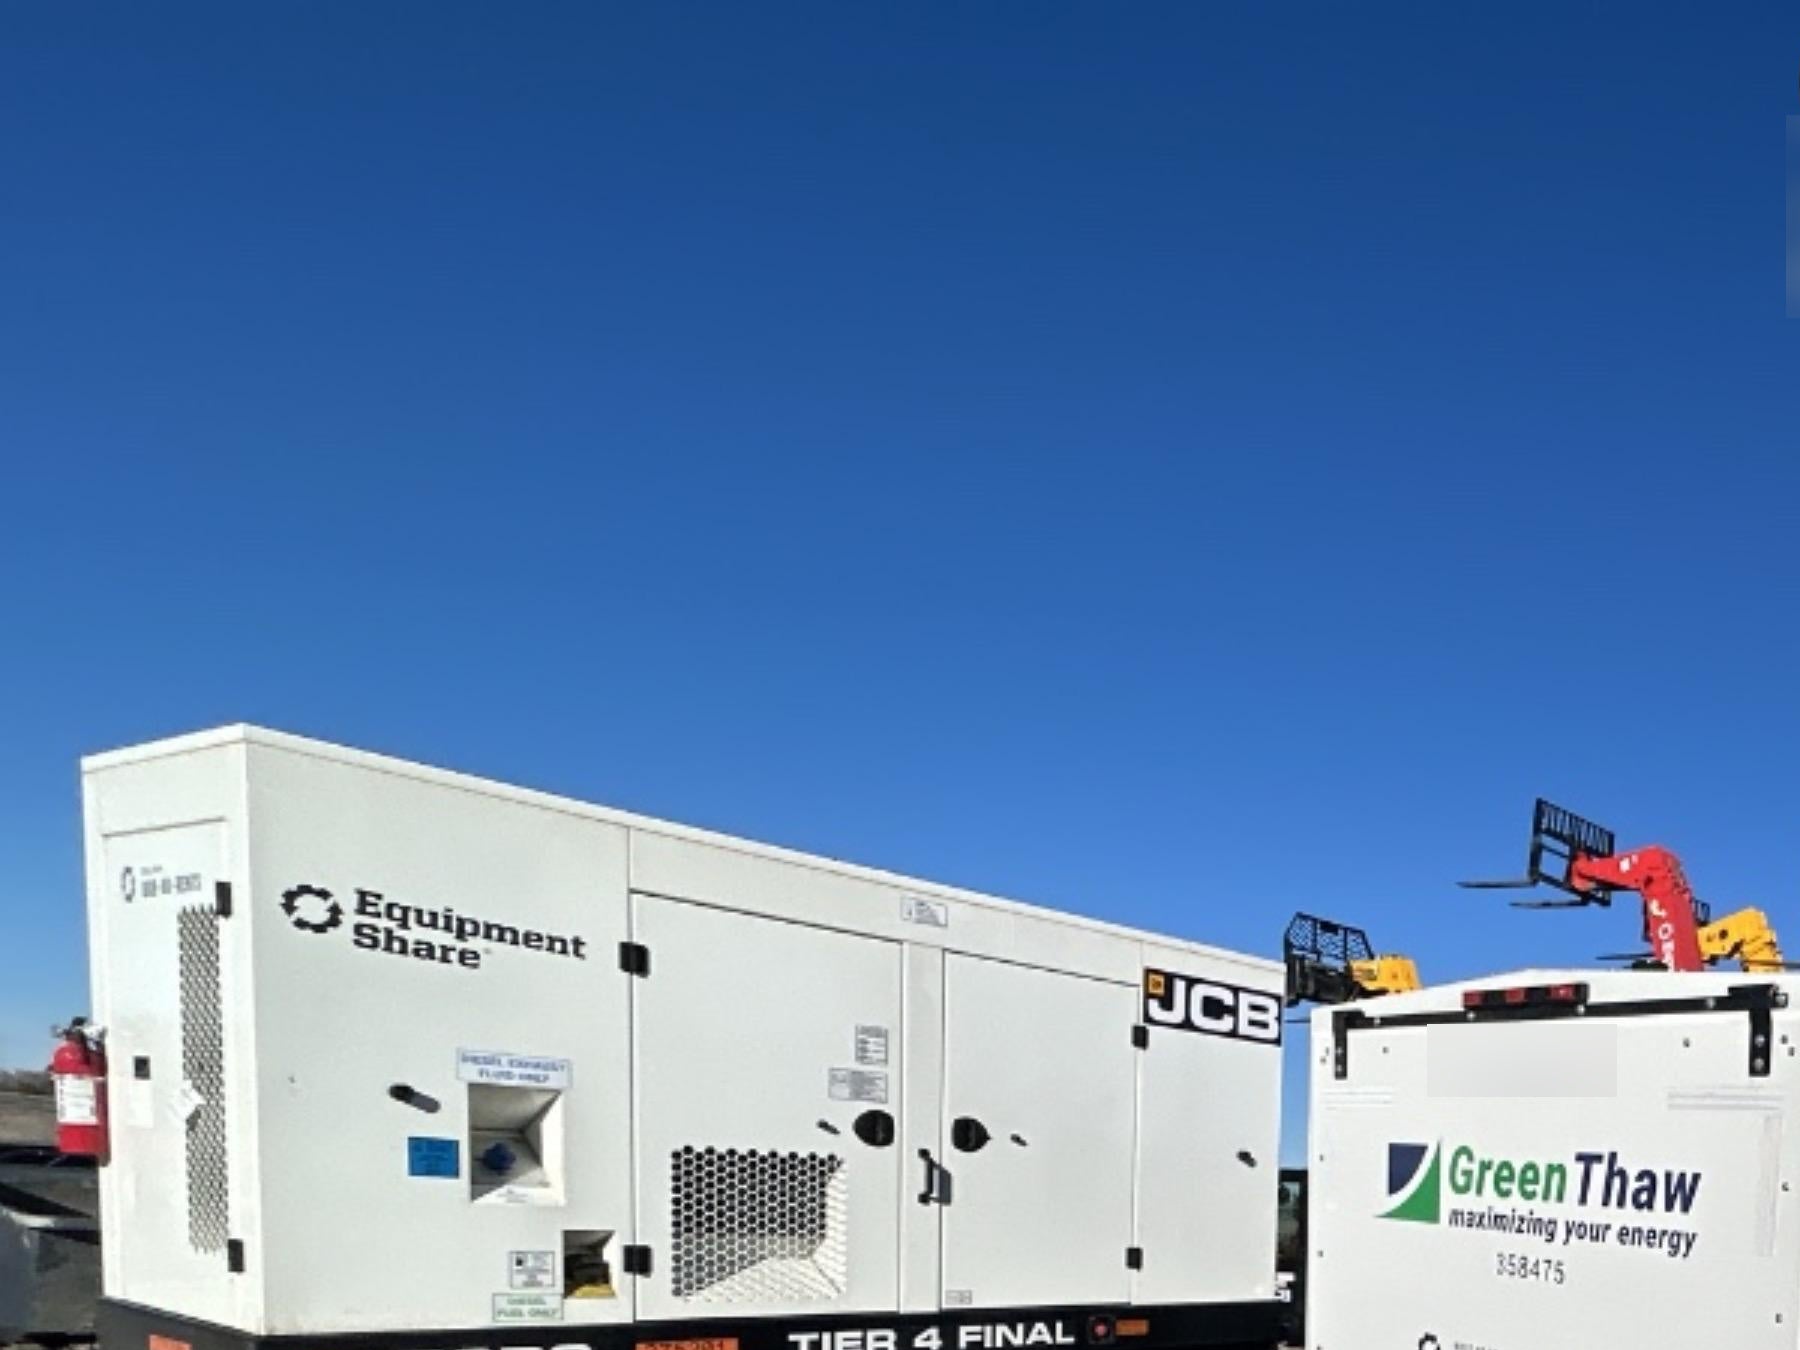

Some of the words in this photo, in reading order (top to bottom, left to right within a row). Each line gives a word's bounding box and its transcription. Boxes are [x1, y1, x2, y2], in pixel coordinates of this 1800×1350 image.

[352, 922, 482, 969] Share
[354, 887, 586, 960] Equipment
[1148, 977, 1280, 1040] JCB
[1448, 1205, 1558, 1243] maximizing
[1562, 1218, 1612, 1246] your
[1616, 1222, 1699, 1259] energy
[1496, 1252, 1566, 1285] 358475
[912, 1325, 943, 1350] 4
[958, 1319, 1076, 1350] FINAL
